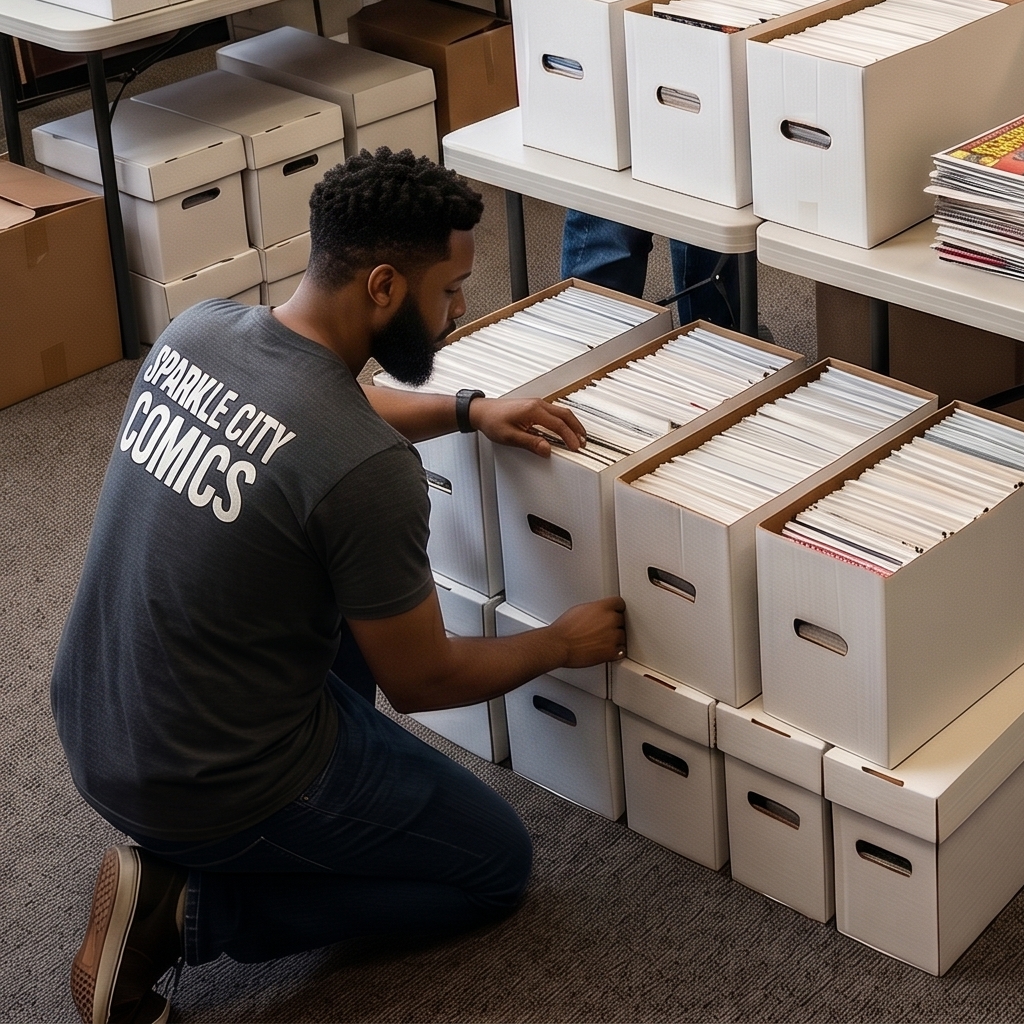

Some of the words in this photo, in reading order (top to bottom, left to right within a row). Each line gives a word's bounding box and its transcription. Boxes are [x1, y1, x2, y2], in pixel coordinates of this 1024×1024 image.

[119, 391, 257, 523] COMICS
[143, 344, 240, 430] SPARKLE
[224, 403, 297, 465] CITY
